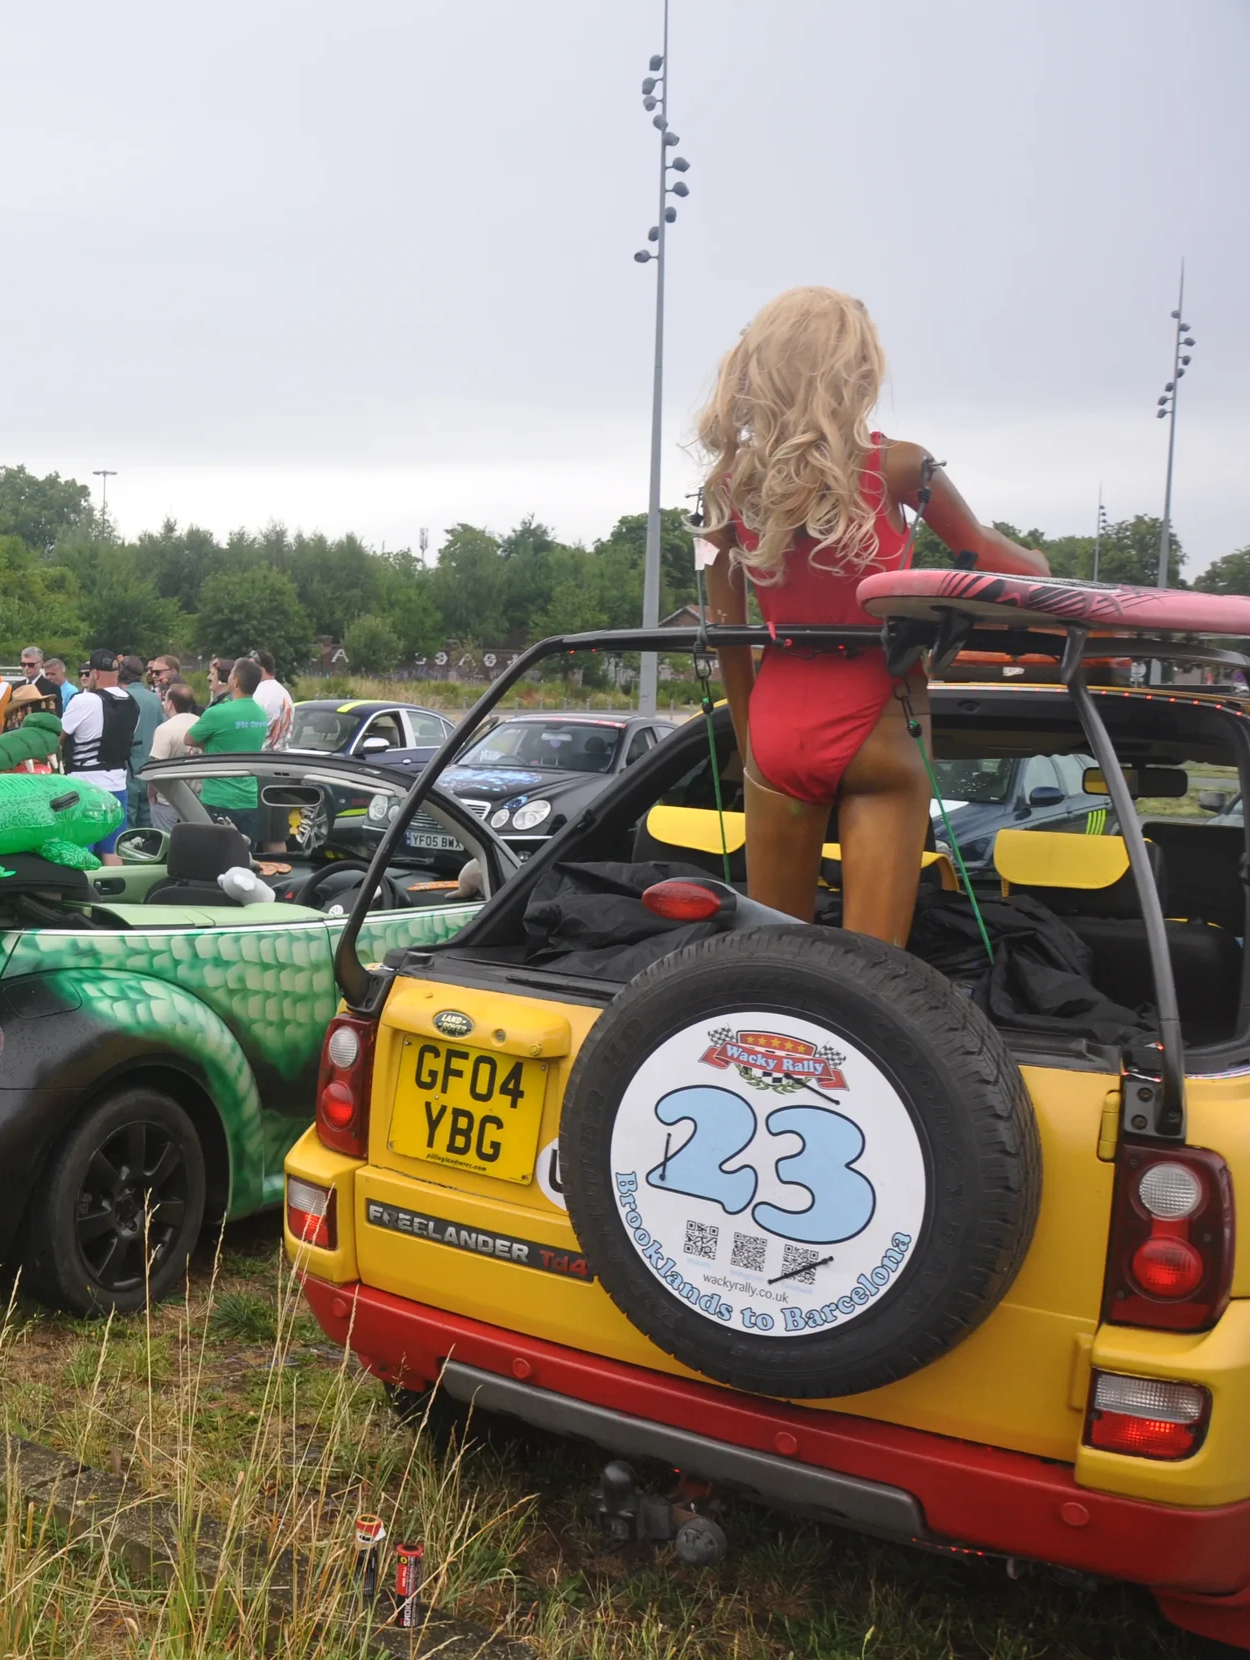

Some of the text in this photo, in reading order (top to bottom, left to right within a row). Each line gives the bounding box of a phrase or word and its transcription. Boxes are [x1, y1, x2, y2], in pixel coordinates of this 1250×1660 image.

[413, 834, 438, 847] YF05
[441, 1014, 462, 1024] LAND
[415, 1044, 524, 1109] GF04
[726, 1044, 824, 1075] Wacky Rally
[425, 1101, 504, 1163] YBG
[646, 1084, 876, 1245] 23
[369, 1204, 589, 1277] FREELANDER Td4
[615, 1171, 912, 1332] Brooklands to Barcelona
[703, 1273, 790, 1304] wackyrally.co.uk
